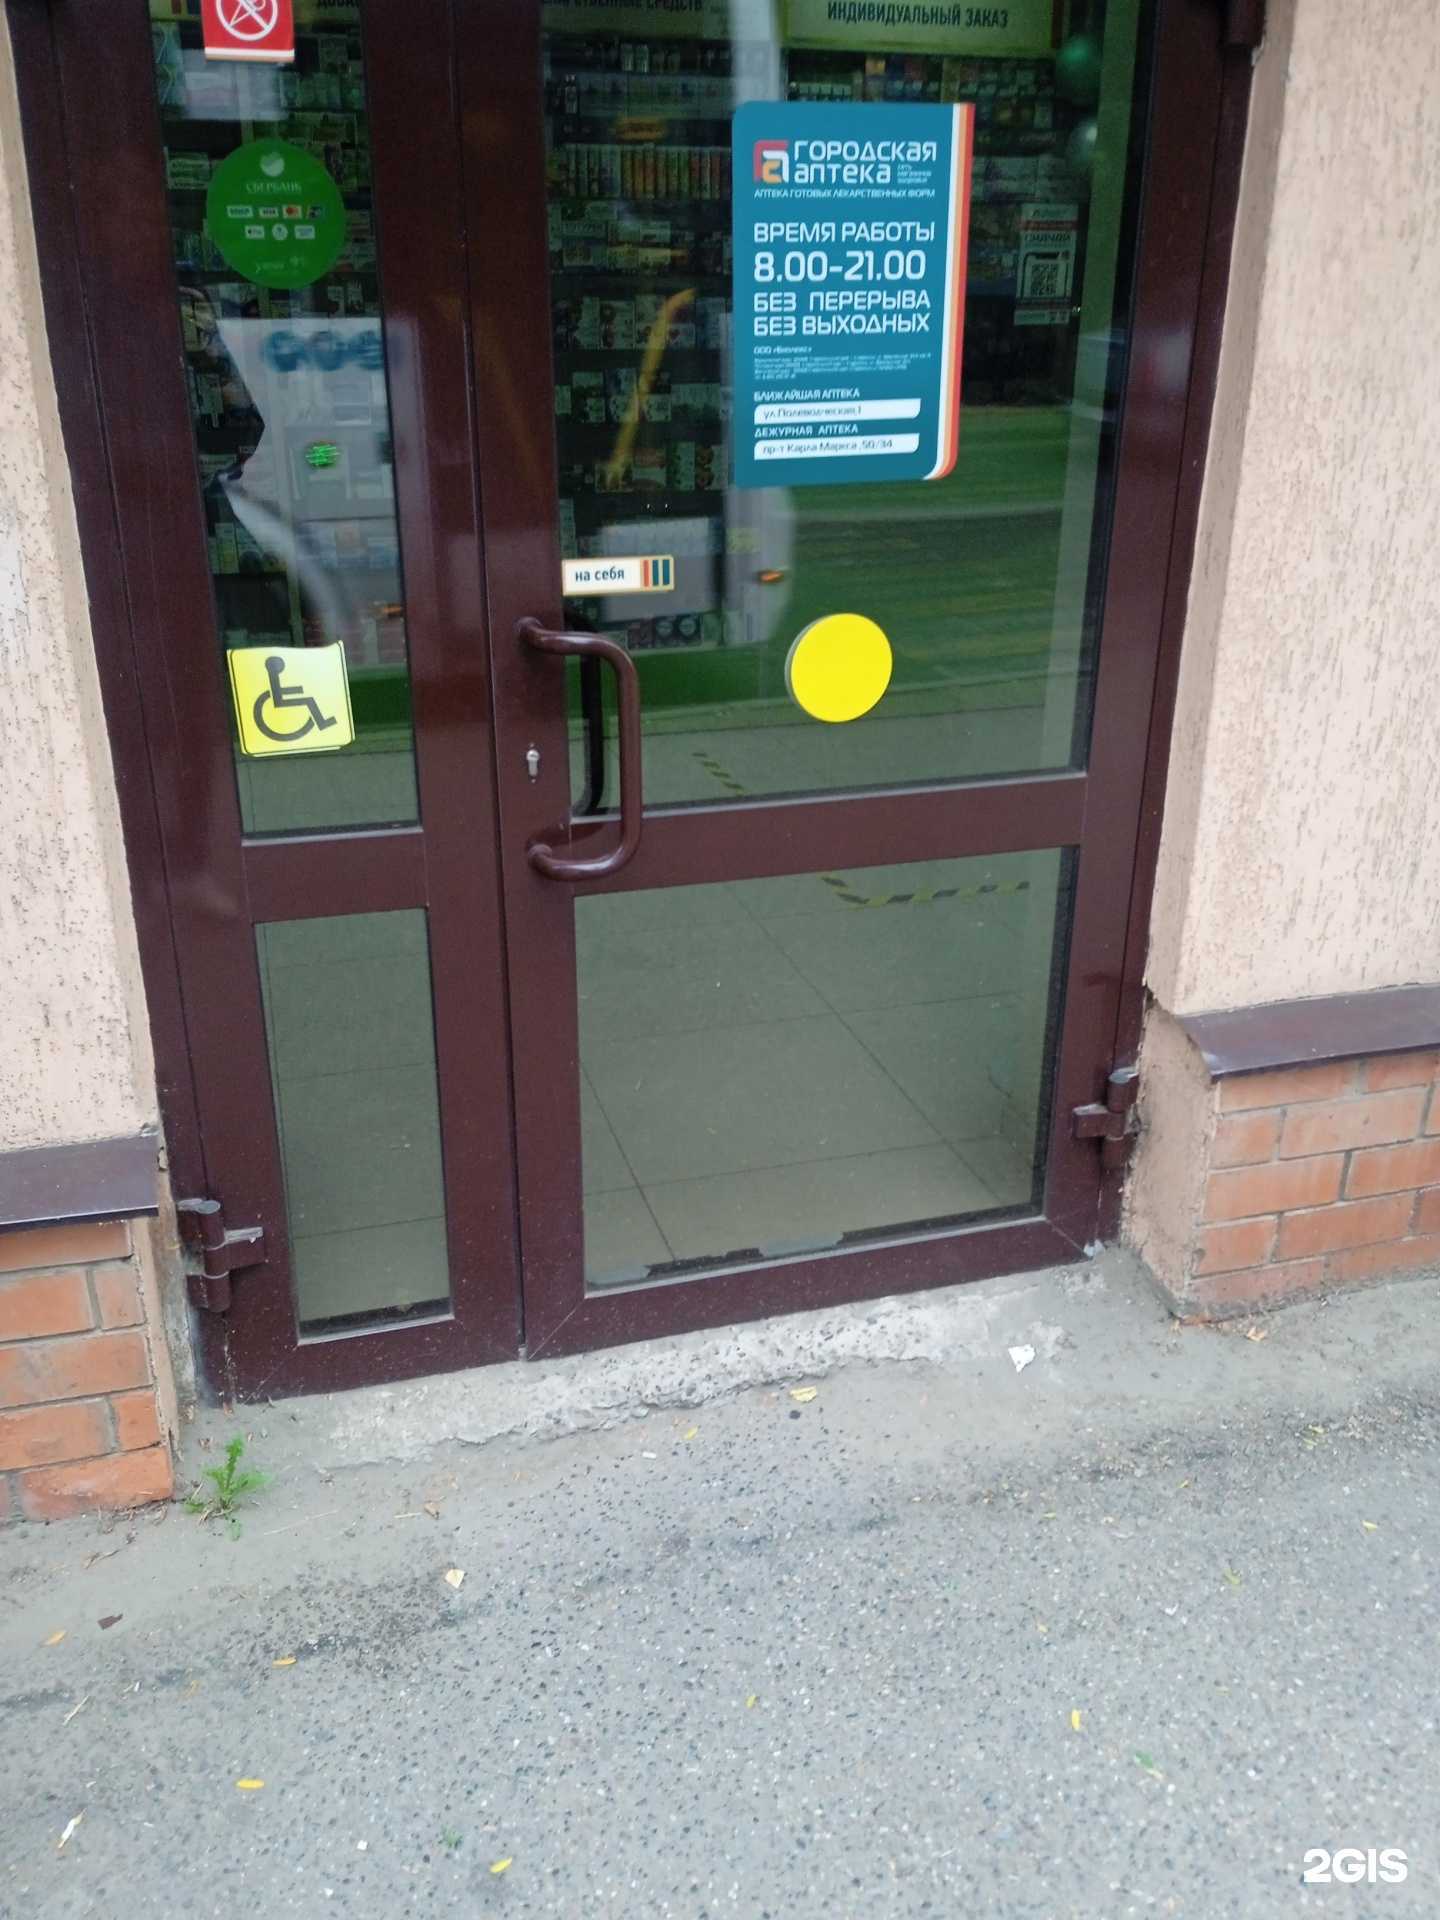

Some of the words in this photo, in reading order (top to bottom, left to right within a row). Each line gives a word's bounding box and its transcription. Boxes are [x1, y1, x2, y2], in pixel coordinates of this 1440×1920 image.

[827, 1, 961, 27] ИНДИВИДУАЛЬНЫЙ
[965, 7, 1009, 28] ЗАКАЗ
[753, 189, 788, 199] АПТЕКА
[789, 189, 832, 199] ГОТОВЫХ
[833, 188, 906, 199] ЛЕКАРСТВЕННЫХ
[908, 188, 936, 198] ФОРМ
[753, 222, 836, 243] ВРЕМЯ
[841, 221, 936, 243] РАБОТЫ
[753, 249, 927, 283] 8.00-21.00
[753, 292, 797, 313] БЕЗ
[809, 289, 931, 312] ПЕРЕРЫВА
[753, 316, 797, 337] БЕЗ
[802, 312, 931, 336] ВЫХОДНЫХ
[753, 390, 821, 402] БЛИЖАЙШАЯ
[821, 388, 860, 400] АПТЕКА
[754, 425, 813, 438] ДЕЖУРНАЯ
[818, 423, 858, 435] АПТЕКА
[787, 443, 818, 454] Карла
[819, 441, 857, 452] Маркса
[575, 570, 591, 582] на
[594, 566, 625, 581] себя
